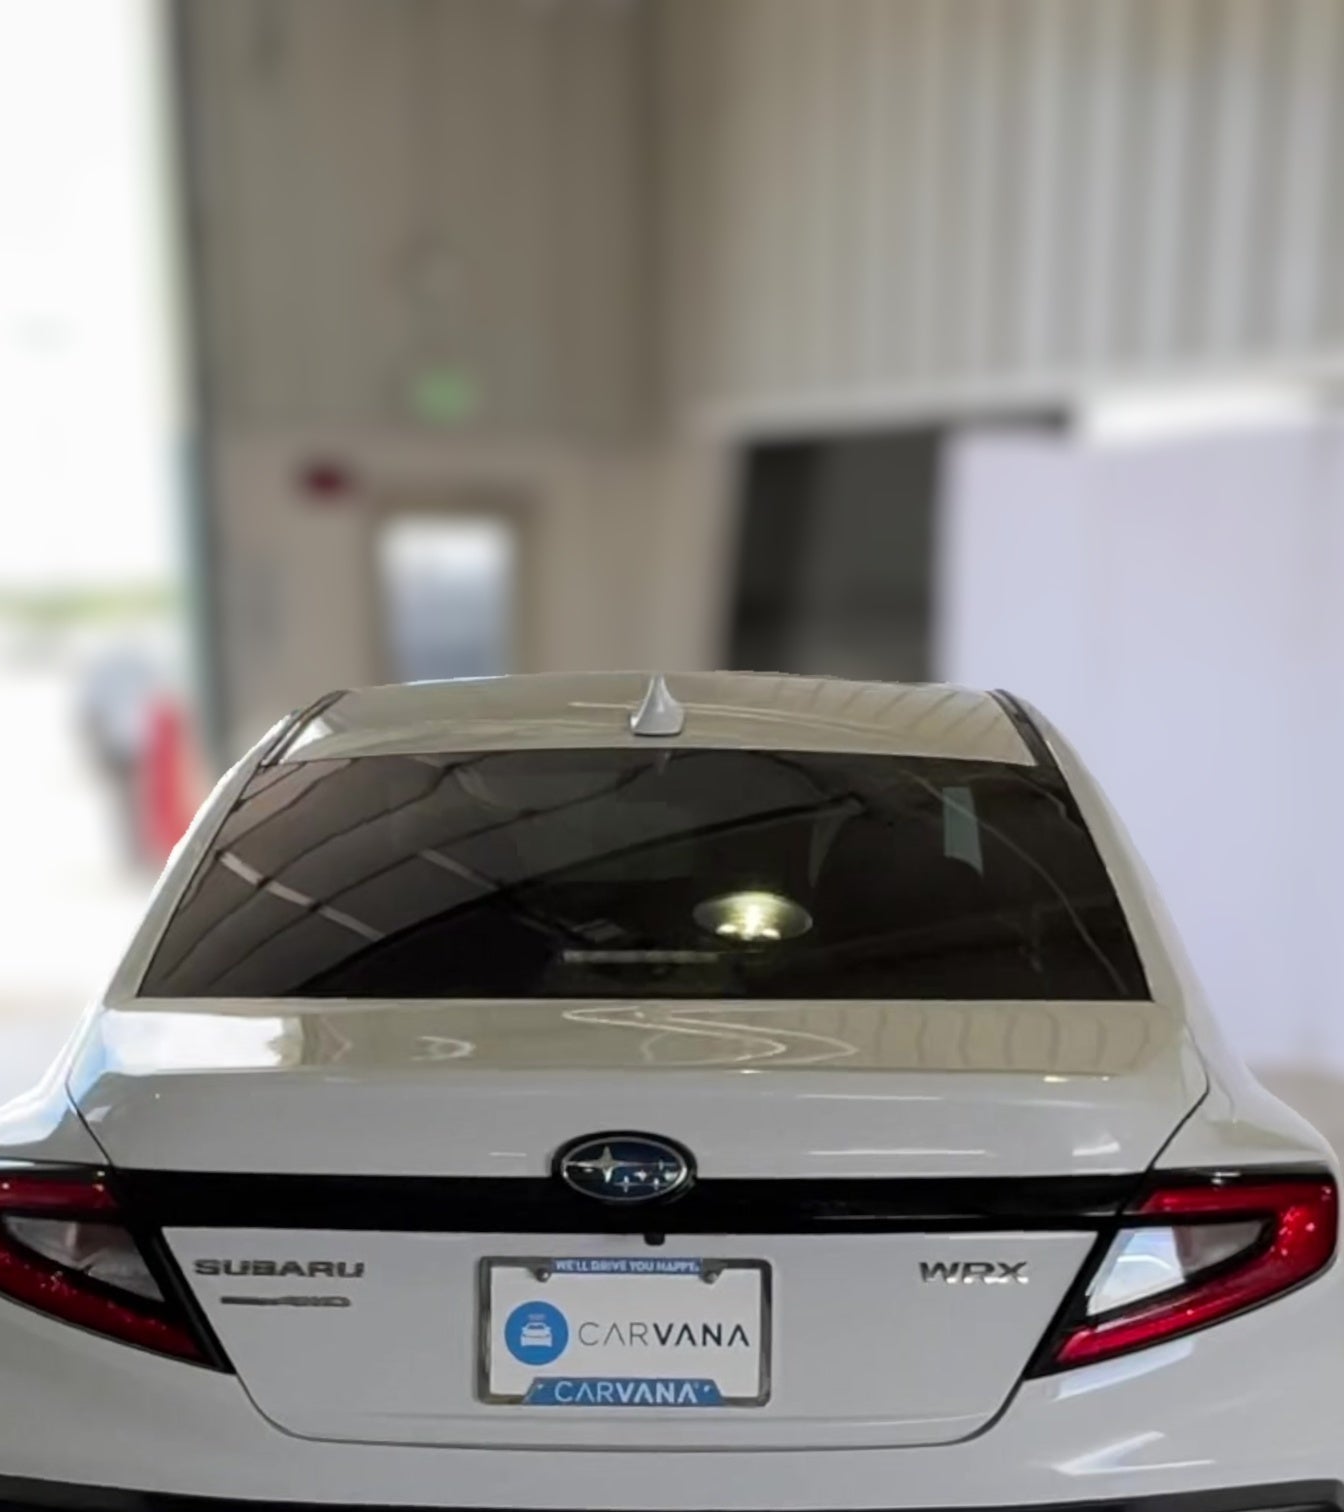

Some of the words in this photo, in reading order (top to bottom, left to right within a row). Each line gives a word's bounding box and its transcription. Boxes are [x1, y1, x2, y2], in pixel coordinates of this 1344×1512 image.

[193, 1258, 365, 1278] SUBARU
[555, 1260, 588, 1272] WE'LL
[590, 1260, 627, 1272] DRIVE
[629, 1260, 655, 1272] YOU
[918, 1261, 1029, 1284] WRX
[578, 1322, 750, 1346] CARVANA
[554, 1381, 699, 1404] CARVANA
